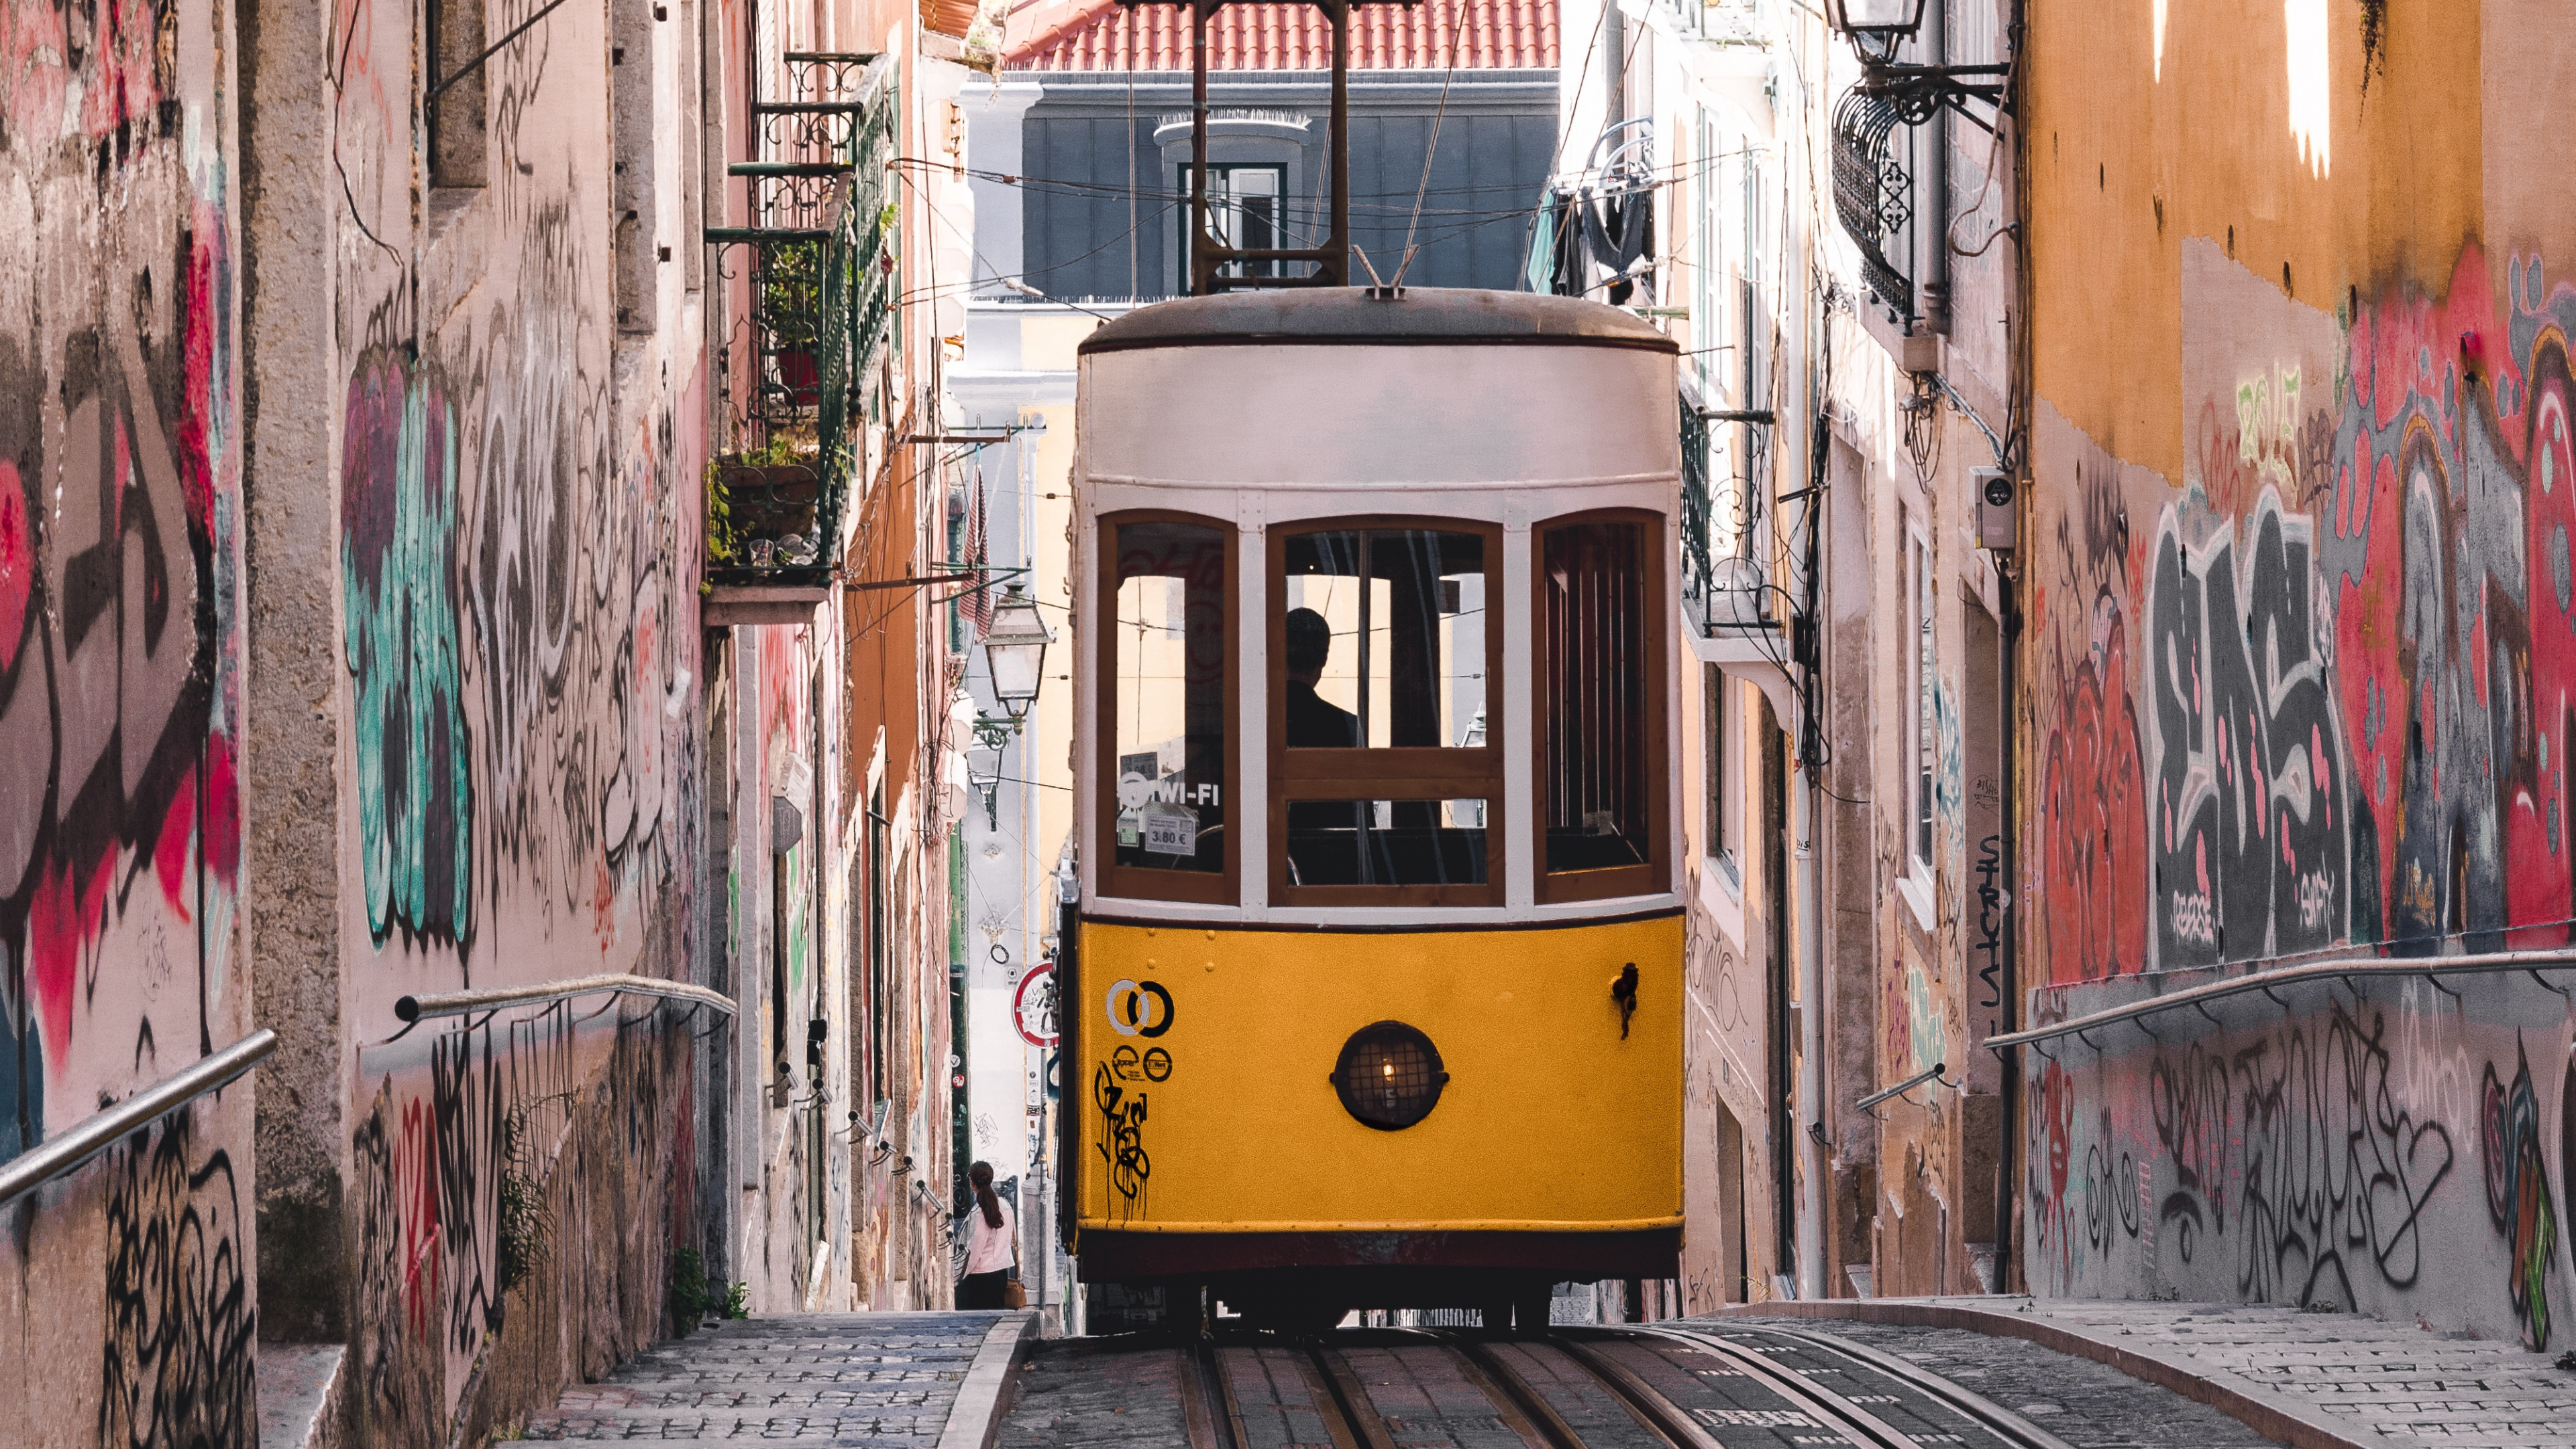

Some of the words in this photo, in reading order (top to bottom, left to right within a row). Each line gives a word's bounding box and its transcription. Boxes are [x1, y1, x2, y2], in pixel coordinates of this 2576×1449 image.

[1159, 780, 1219, 806] WI-FI
[1152, 830, 1176, 844] 3.80
[1179, 833, 1187, 845] €
